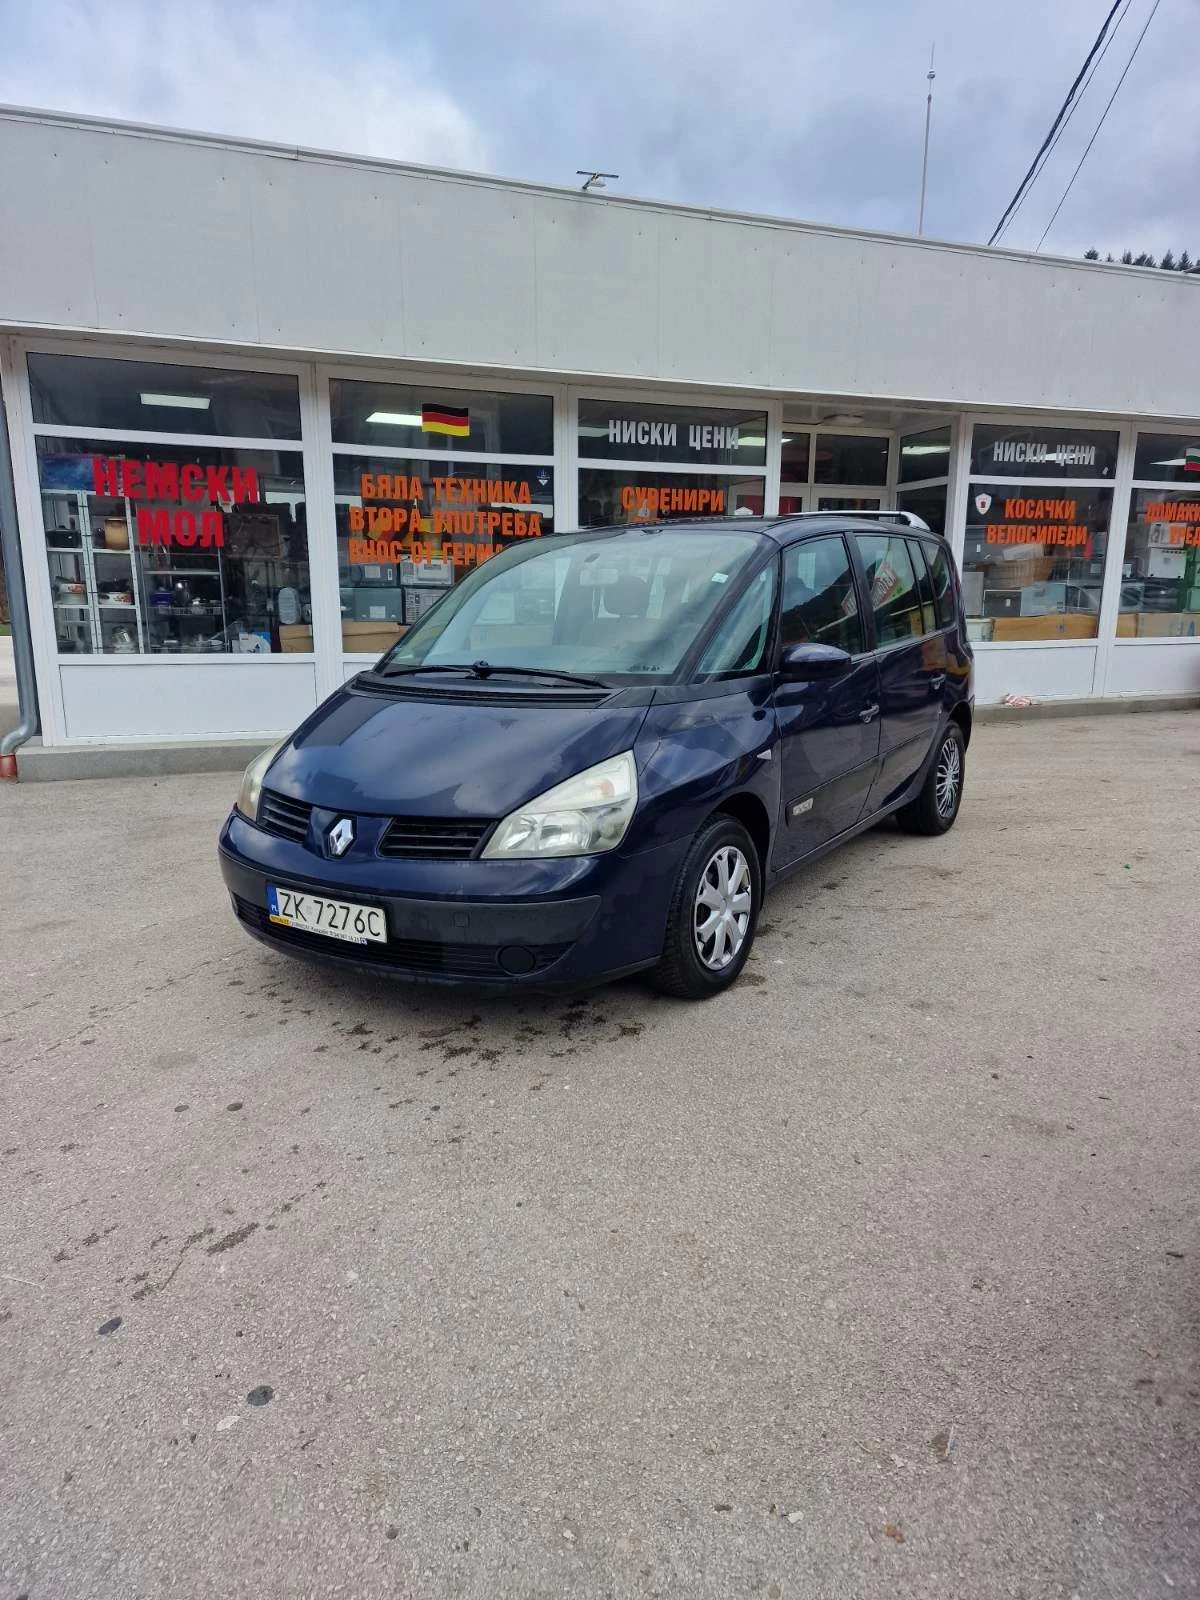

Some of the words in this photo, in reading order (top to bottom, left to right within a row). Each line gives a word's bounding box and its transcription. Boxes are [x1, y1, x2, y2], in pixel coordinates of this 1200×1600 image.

[608, 419, 677, 447] НИСКИ
[688, 424, 739, 450] ЦЕНИ
[993, 441, 1047, 463] НИСКИ
[1055, 444, 1096, 467] ЦЕНИ
[92, 456, 259, 504] НЕМСКИ
[361, 474, 423, 500] БЯЛА
[432, 477, 531, 504] ТЕХНИКА
[622, 487, 724, 512] СУВЕНИРИ
[1005, 498, 1076, 519] КОСАЧКИ
[137, 508, 225, 547] МОЛ
[349, 506, 422, 533] ВТОРА
[431, 508, 542, 537] УПОТРЕБА
[987, 524, 1088, 547] ВЕЛОСИПЕДИ
[348, 539, 402, 565] ВНОС
[280, 892, 308, 922] ZK
[313, 899, 381, 937] 7276C
